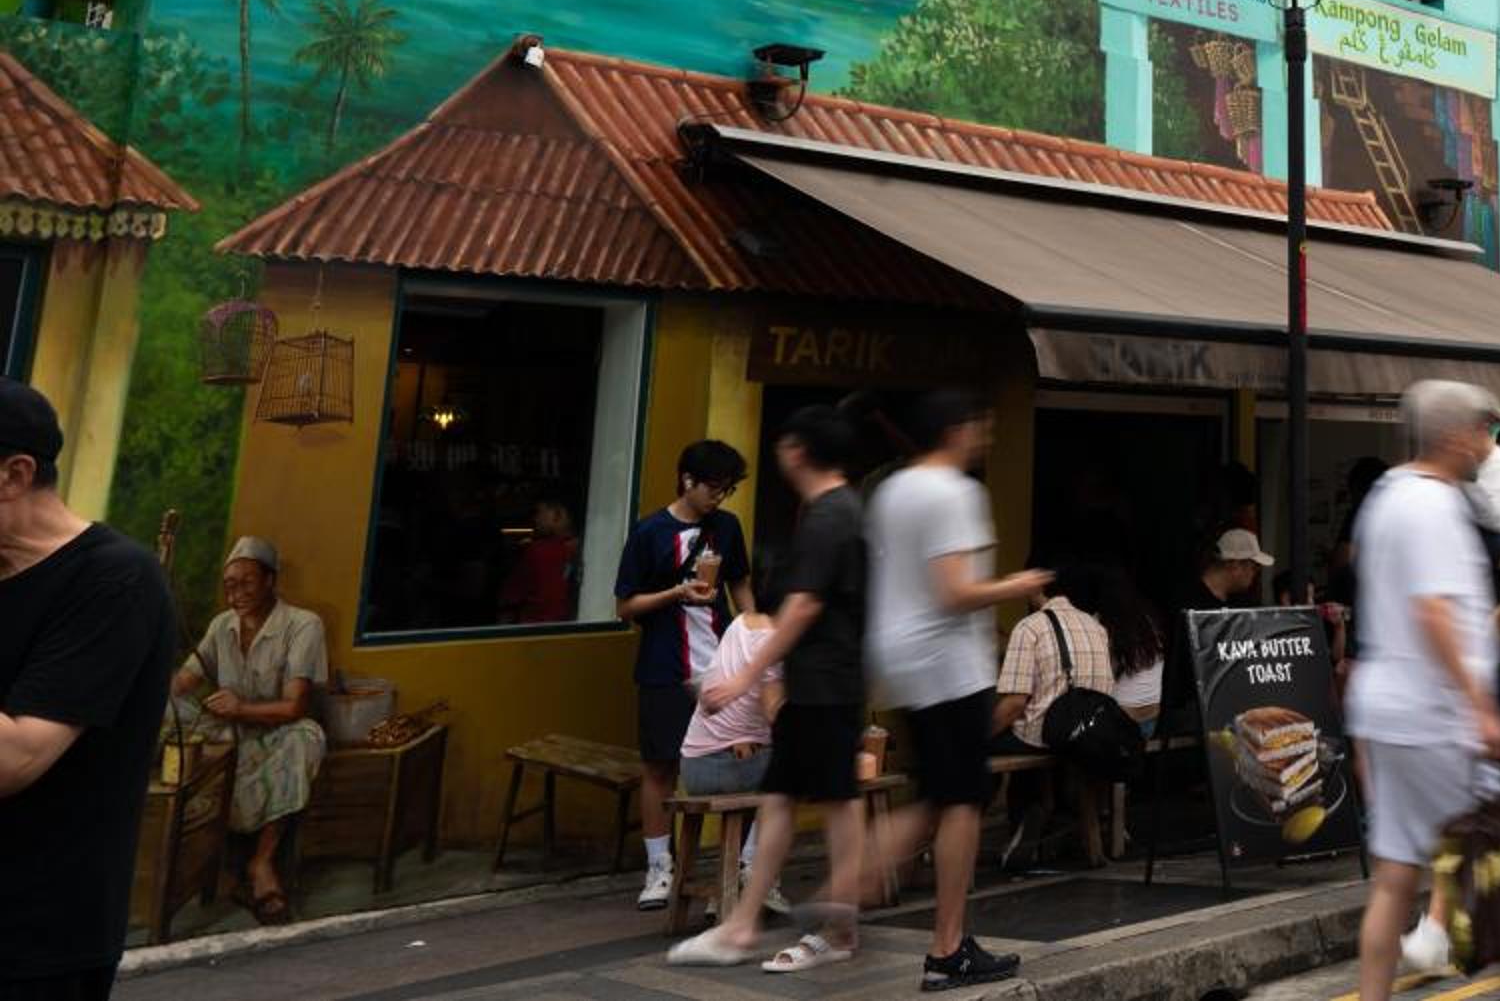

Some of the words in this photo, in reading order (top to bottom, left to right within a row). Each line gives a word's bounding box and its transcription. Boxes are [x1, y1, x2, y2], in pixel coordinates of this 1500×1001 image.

[1415, 24, 1468, 57] Gelam
[768, 325, 896, 374] TARIK
[1217, 639, 1258, 661] KAYA
[1261, 636, 1314, 658] BUTTER
[1247, 662, 1292, 684] TOAST
